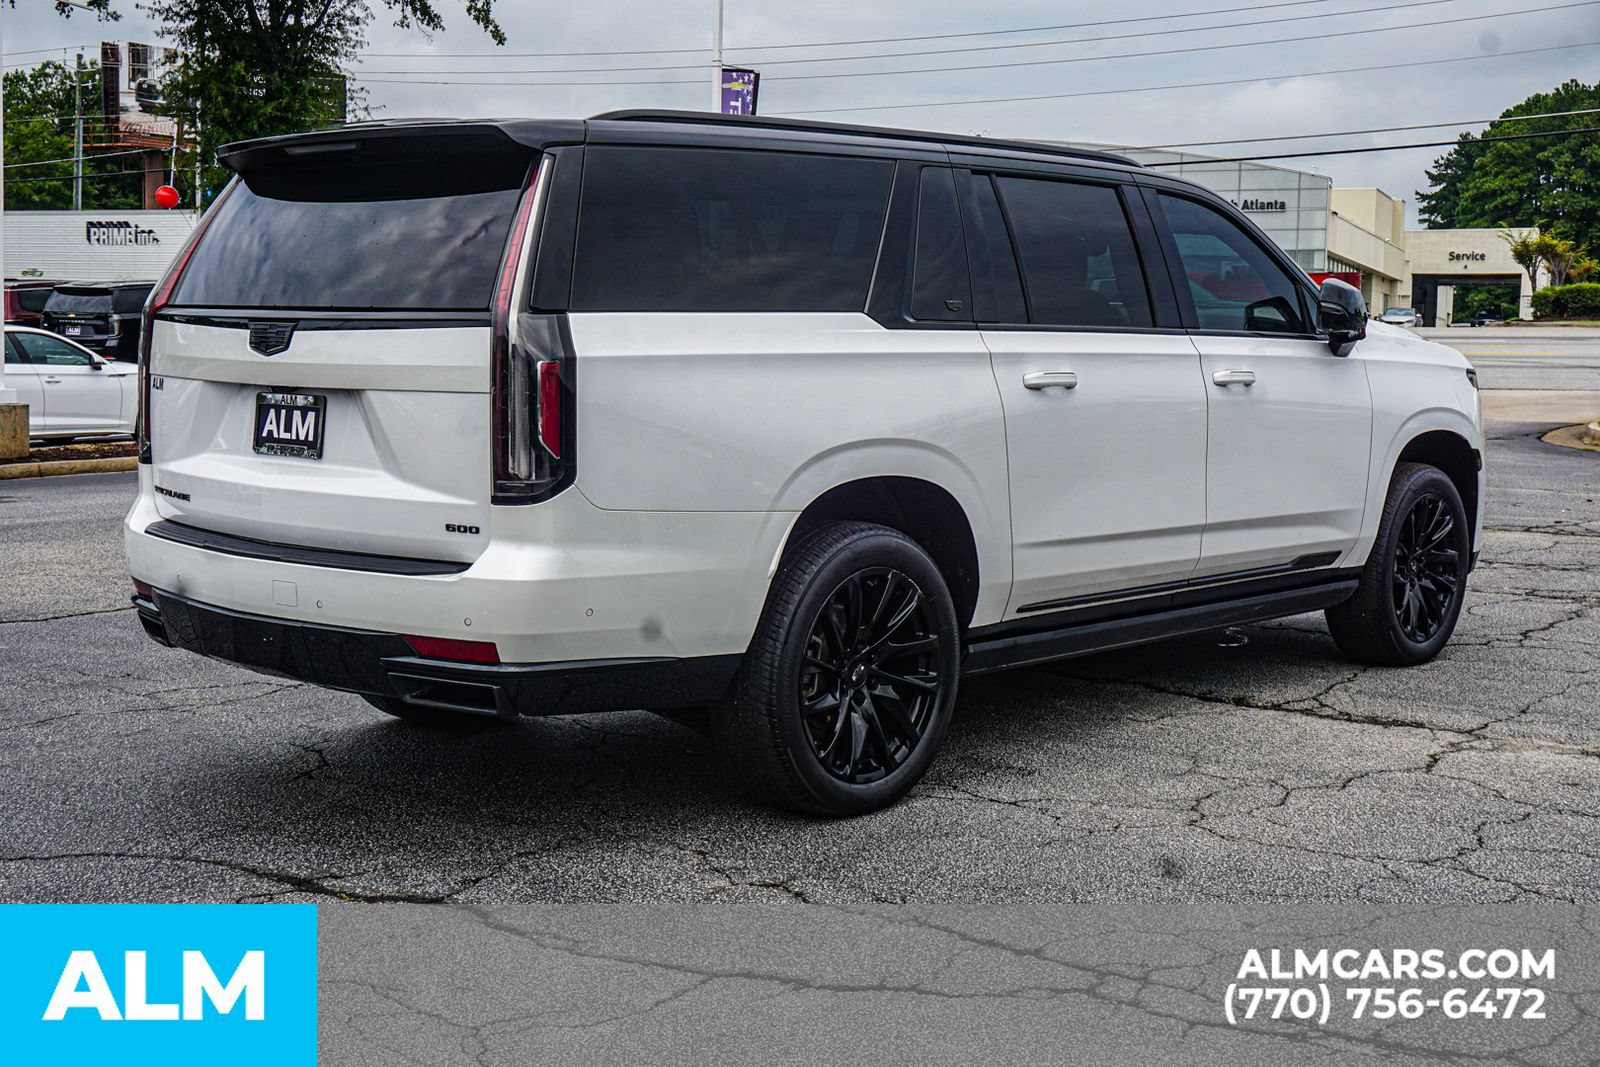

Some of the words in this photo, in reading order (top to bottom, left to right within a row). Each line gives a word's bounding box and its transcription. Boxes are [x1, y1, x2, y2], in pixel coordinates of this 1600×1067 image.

[1240, 198, 1286, 210] Atlanta
[86, 221, 133, 246] PRIME
[1448, 250, 1486, 261] Service
[152, 376, 164, 391] ALM
[280, 394, 297, 405] ALM
[261, 408, 316, 441] ALM
[445, 523, 480, 534] 600
